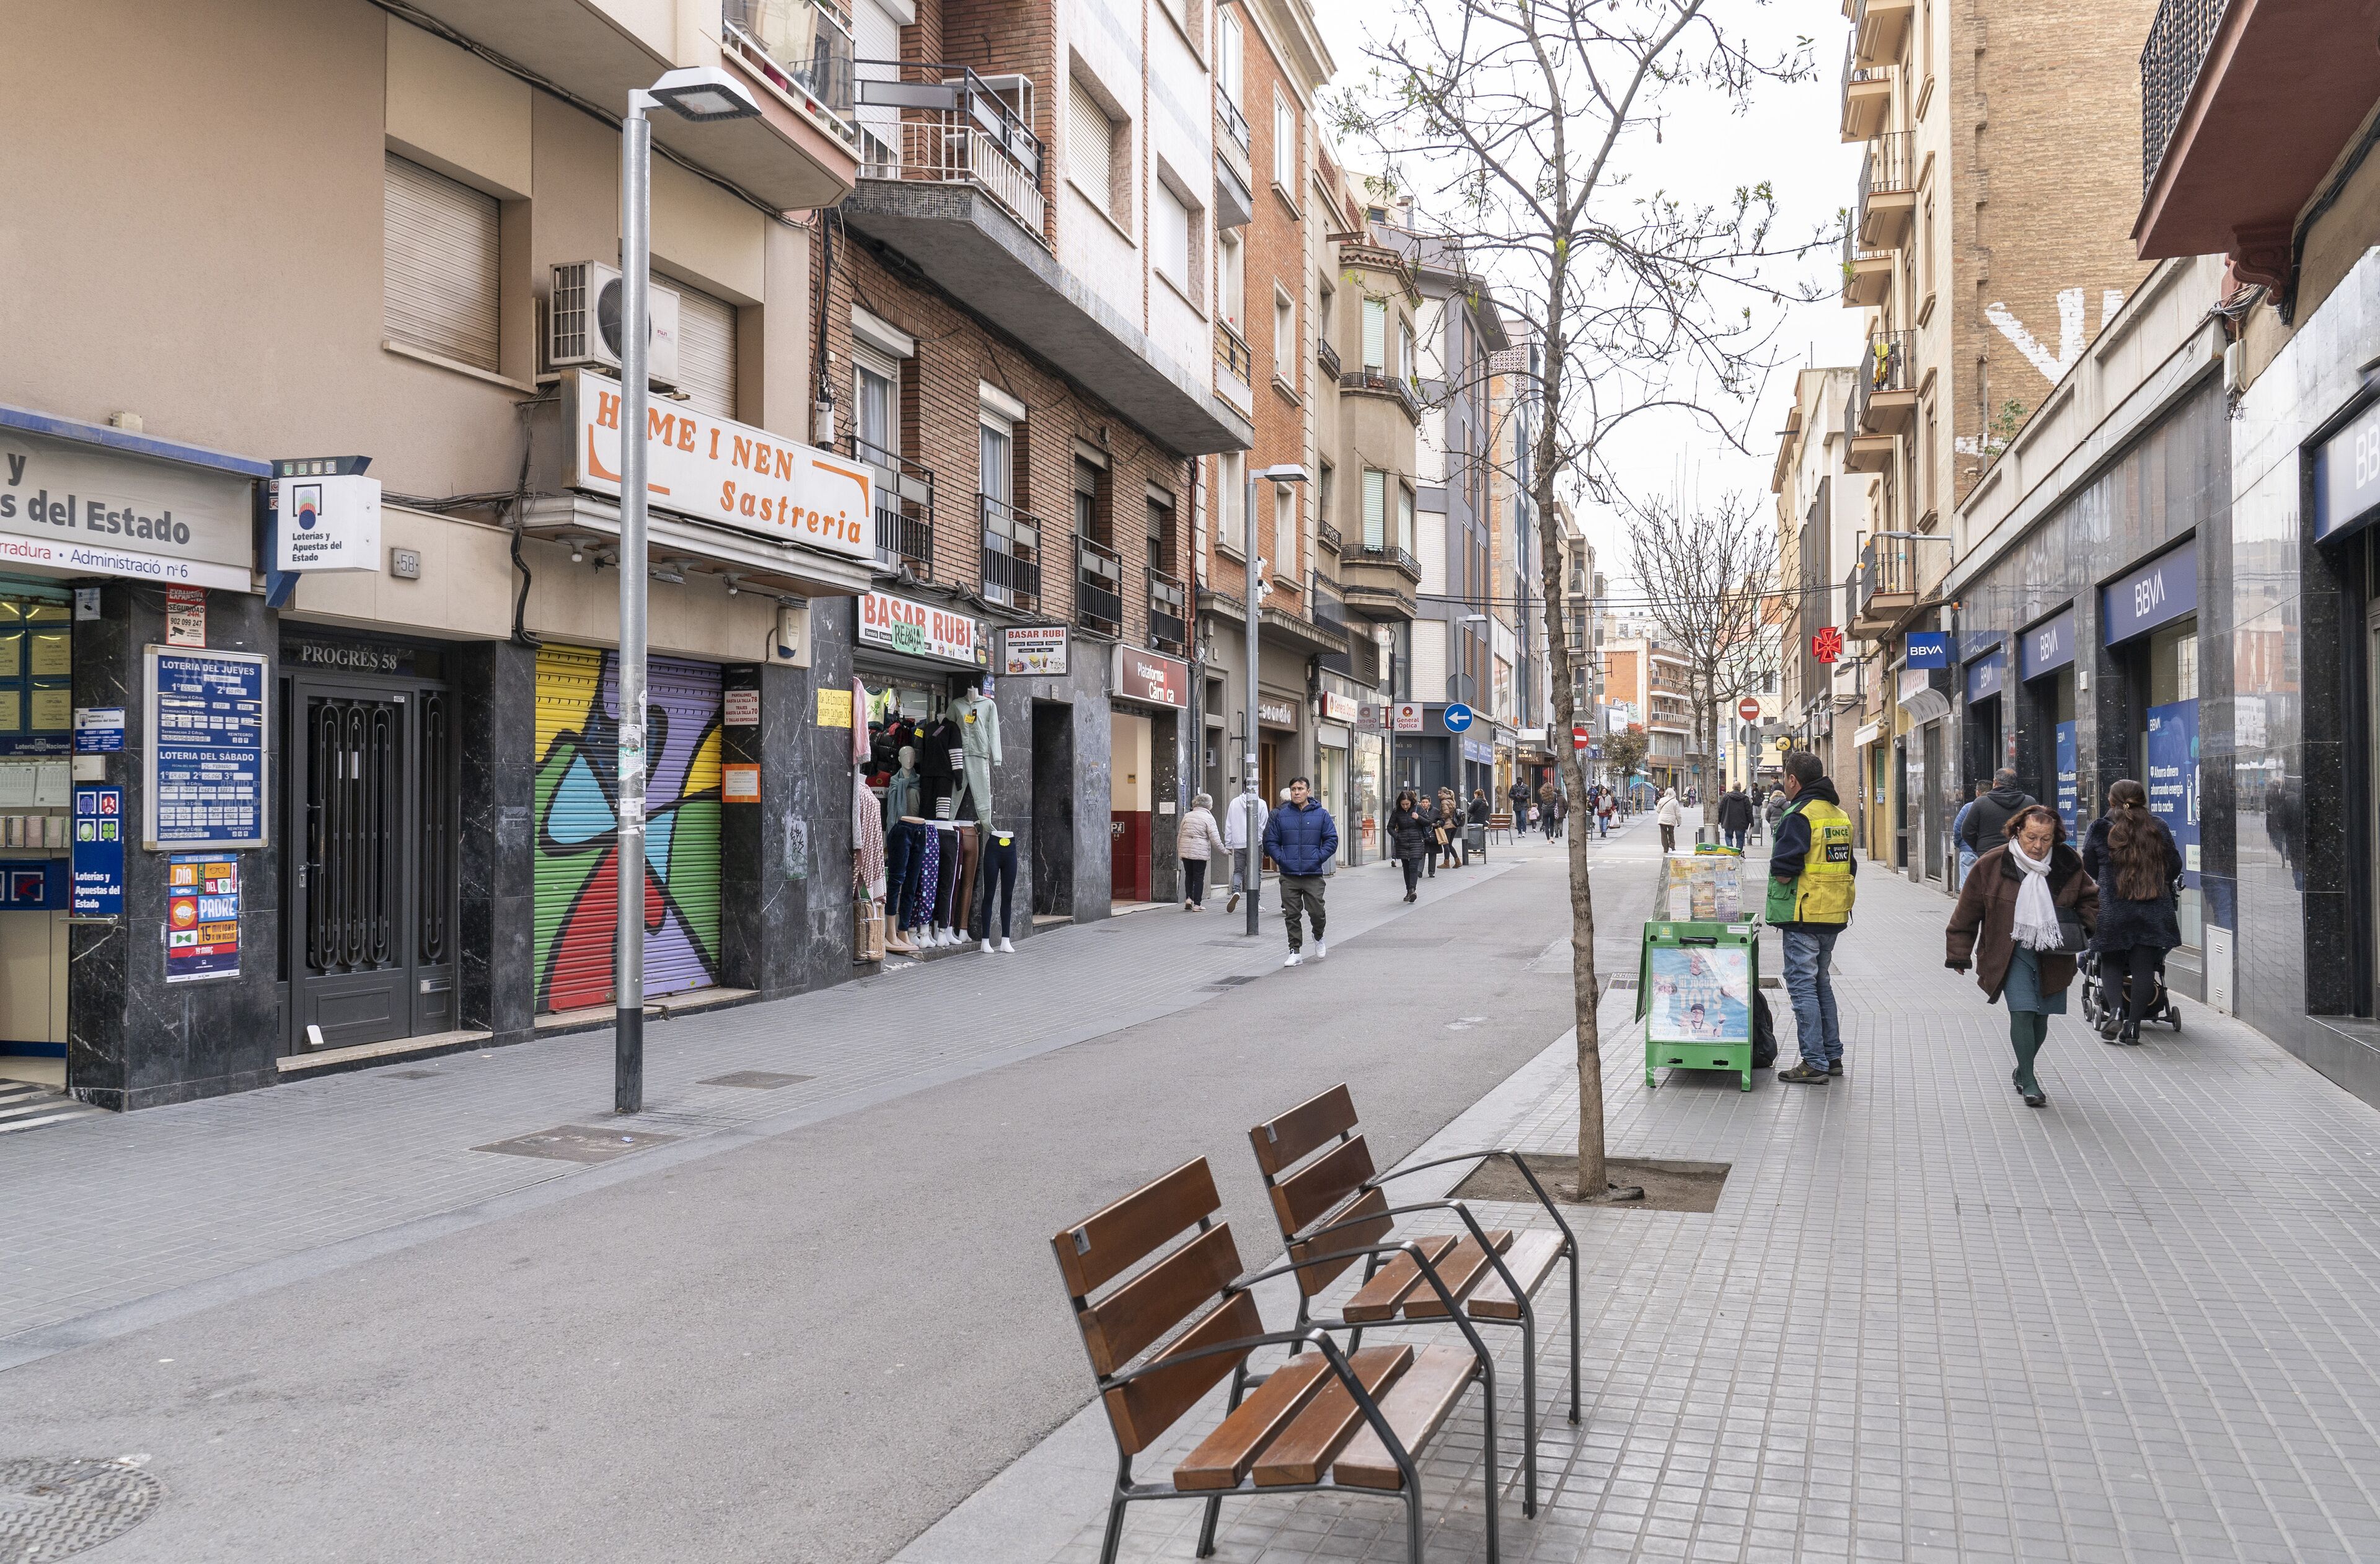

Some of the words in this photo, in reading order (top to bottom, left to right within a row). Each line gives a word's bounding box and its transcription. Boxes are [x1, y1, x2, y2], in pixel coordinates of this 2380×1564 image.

[596, 391, 695, 453] HME
[709, 428, 721, 460] I
[731, 435, 794, 481] NEN
[7, 453, 27, 486] y
[28, 489, 76, 528] del
[87, 500, 190, 544] Estado
[720, 480, 860, 544] Sastreria
[293, 531, 324, 541] Loterías
[293, 542, 328, 552] Apuestas
[330, 541, 342, 549] del
[71, 549, 161, 575] Administració
[292, 554, 319, 562] Estado
[400, 554, 415, 572] 58
[2135, 568, 2165, 617] BBVA
[169, 604, 204, 614] SEGURIDAD
[864, 594, 926, 637] BASAR
[933, 611, 971, 647] RUBI
[894, 624, 923, 651] REBAJA
[1008, 630, 1039, 638] BASAR
[1910, 645, 1943, 655] BBVA
[2040, 625, 2058, 662] BBVA
[302, 645, 378, 668] PROGRÉS
[382, 654, 397, 669] 58
[162, 661, 200, 671] LOTERIA
[203, 665, 219, 673] DEL
[222, 666, 255, 676] JUEVES
[1137, 661, 1164, 683] Plataforma
[1980, 661, 1993, 688] BBVA
[1263, 704, 1291, 724] secreto
[1334, 700, 1346, 714] General
[1346, 702, 1355, 717] Optica
[2149, 717, 2161, 731] BBVA
[160, 751, 198, 760] LOTERIA
[200, 753, 217, 761] DEL
[219, 751, 254, 761] SÁBADO
[2154, 766, 2166, 777] Ahorra
[2167, 764, 2179, 777] dinero
[2151, 784, 2169, 795] ahorrando
[2169, 781, 2183, 797] energía
[2157, 801, 2162, 812] tu
[2162, 800, 2174, 813] coche
[1834, 852, 1848, 860] ONC
[75, 872, 104, 881] Loterías
[105, 873, 110, 883] y
[175, 866, 192, 885] DÍA
[75, 886, 107, 896] Apuestas
[108, 885, 120, 895] del
[205, 881, 217, 893] DEL
[75, 899, 99, 908] Estado
[200, 898, 236, 919] PADRE
[200, 926, 211, 942] 15
[212, 924, 235, 932] MILIONS
[1679, 989, 1722, 1009] TOTS
